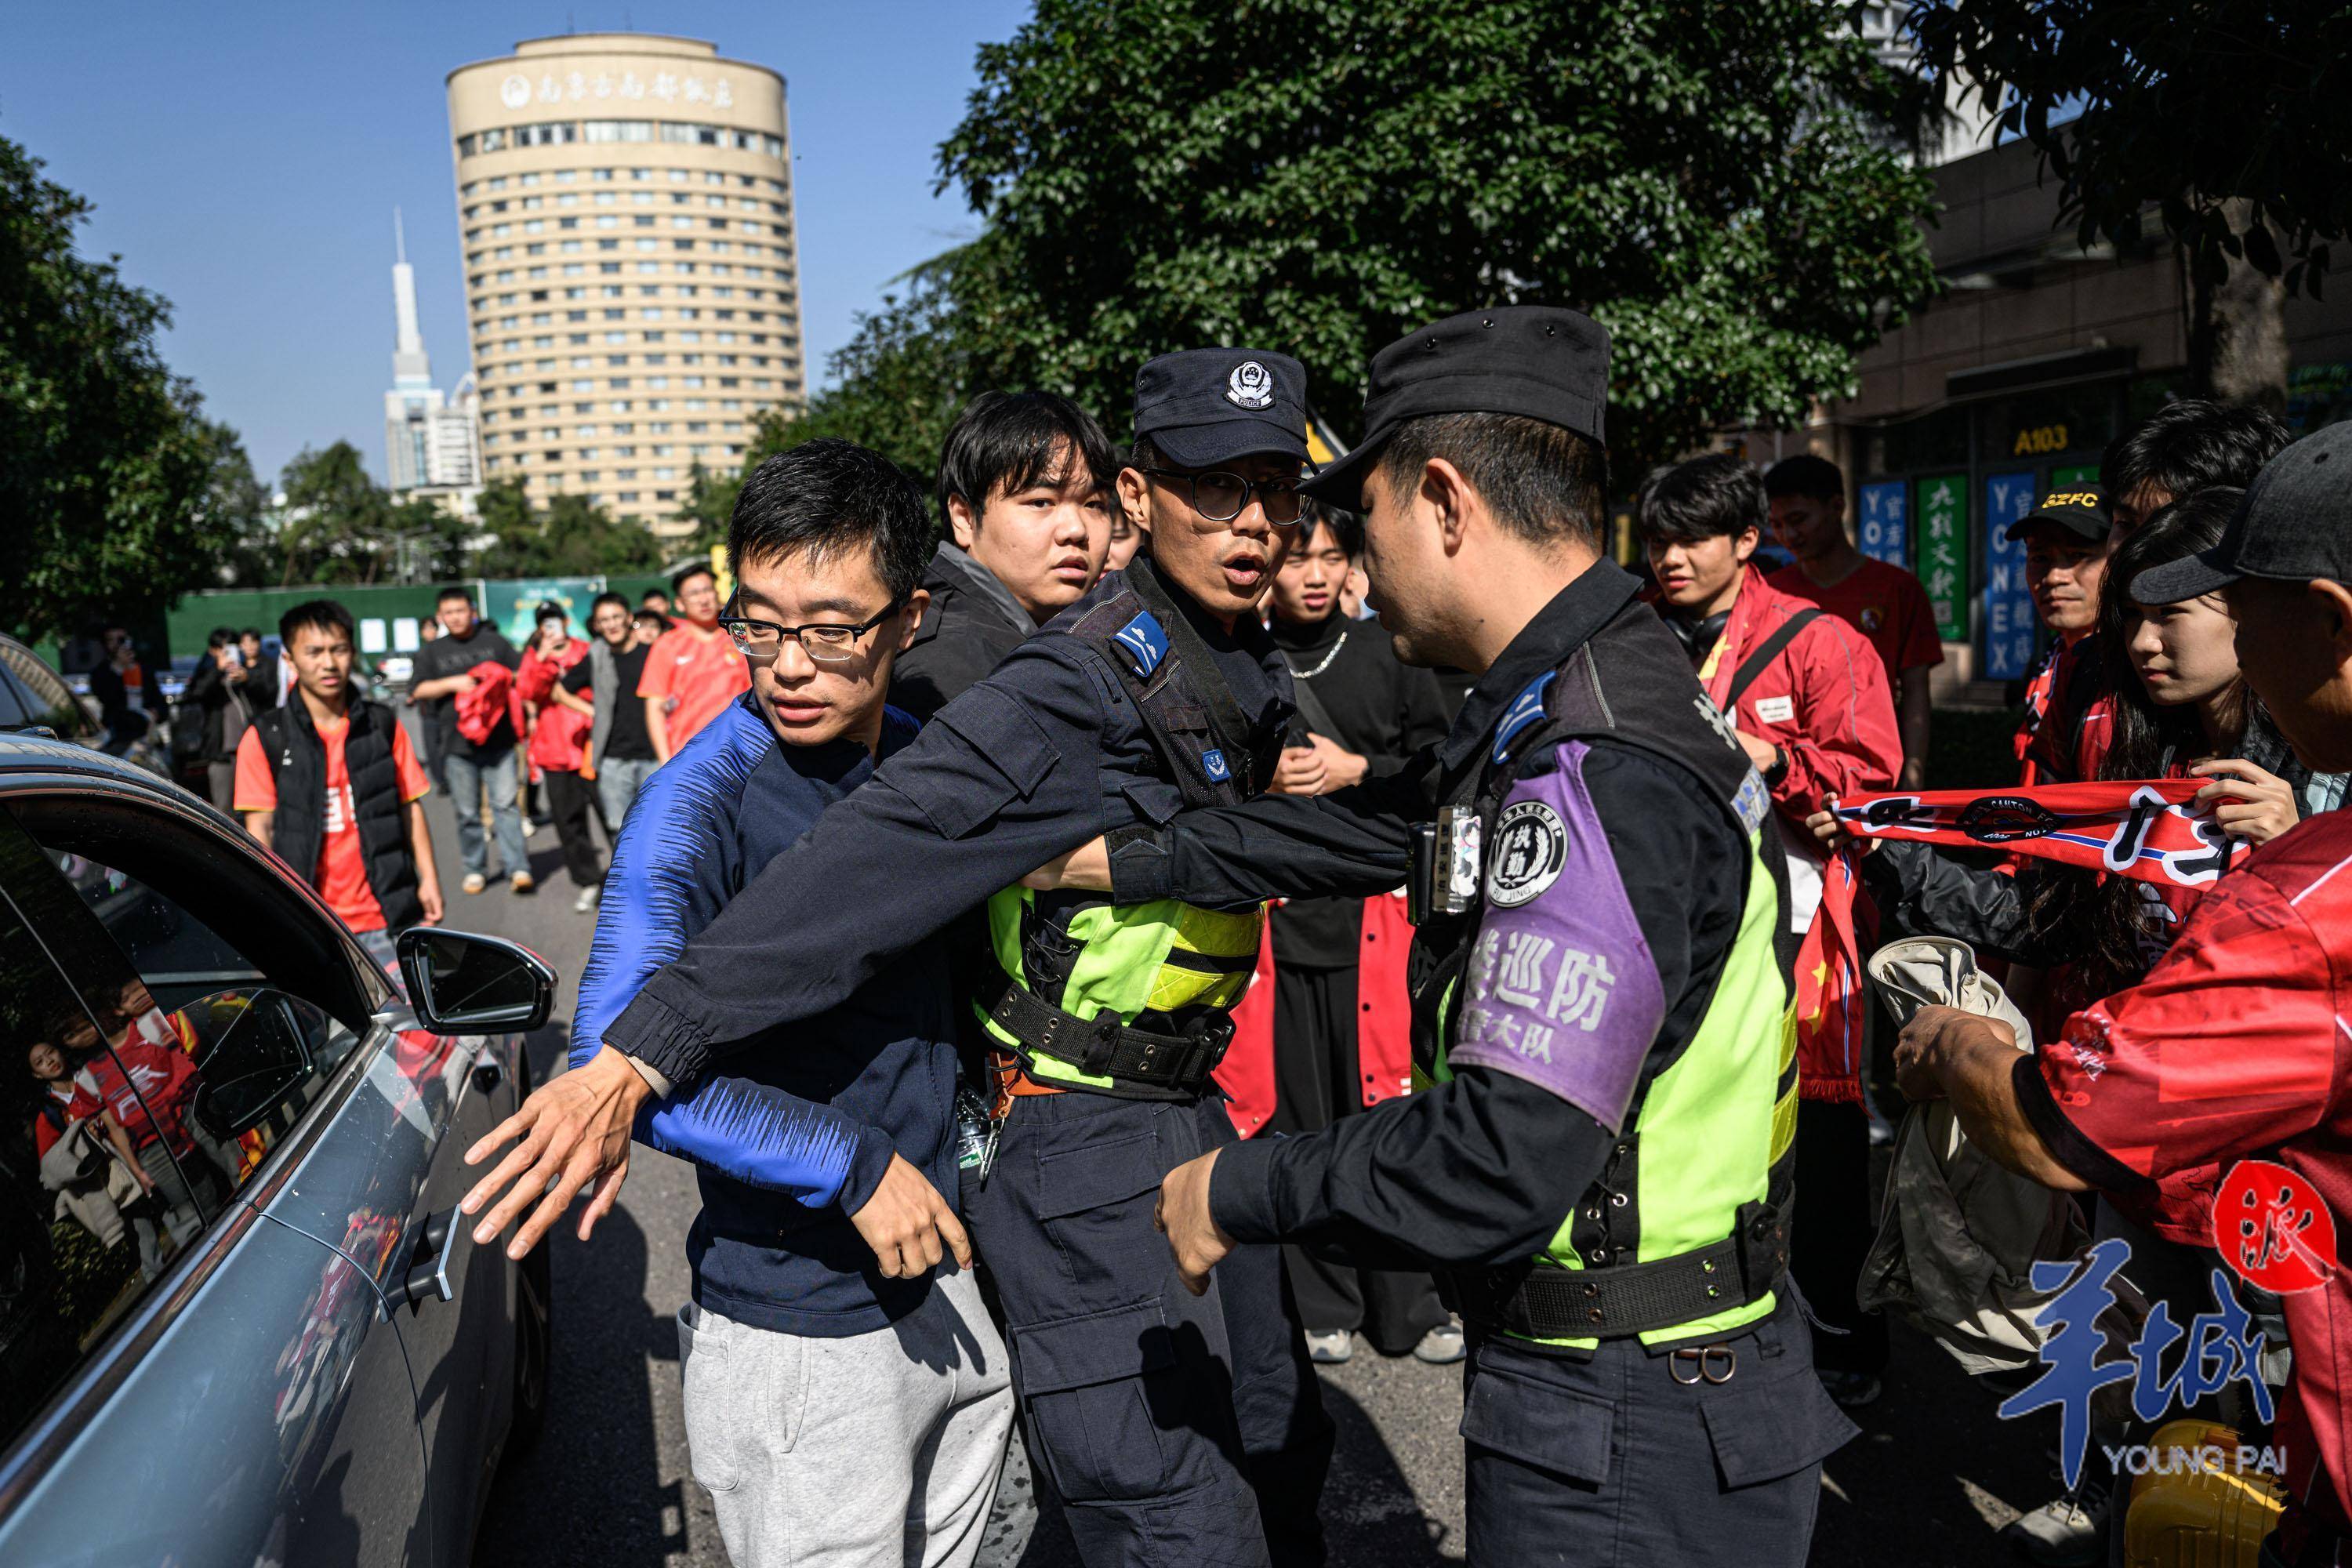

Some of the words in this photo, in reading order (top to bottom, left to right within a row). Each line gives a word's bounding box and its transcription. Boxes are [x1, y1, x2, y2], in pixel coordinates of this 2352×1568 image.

[2014, 425, 2068, 456] A103
[1991, 483, 2010, 673] YONEX
[1504, 823, 1532, 877] 执勤
